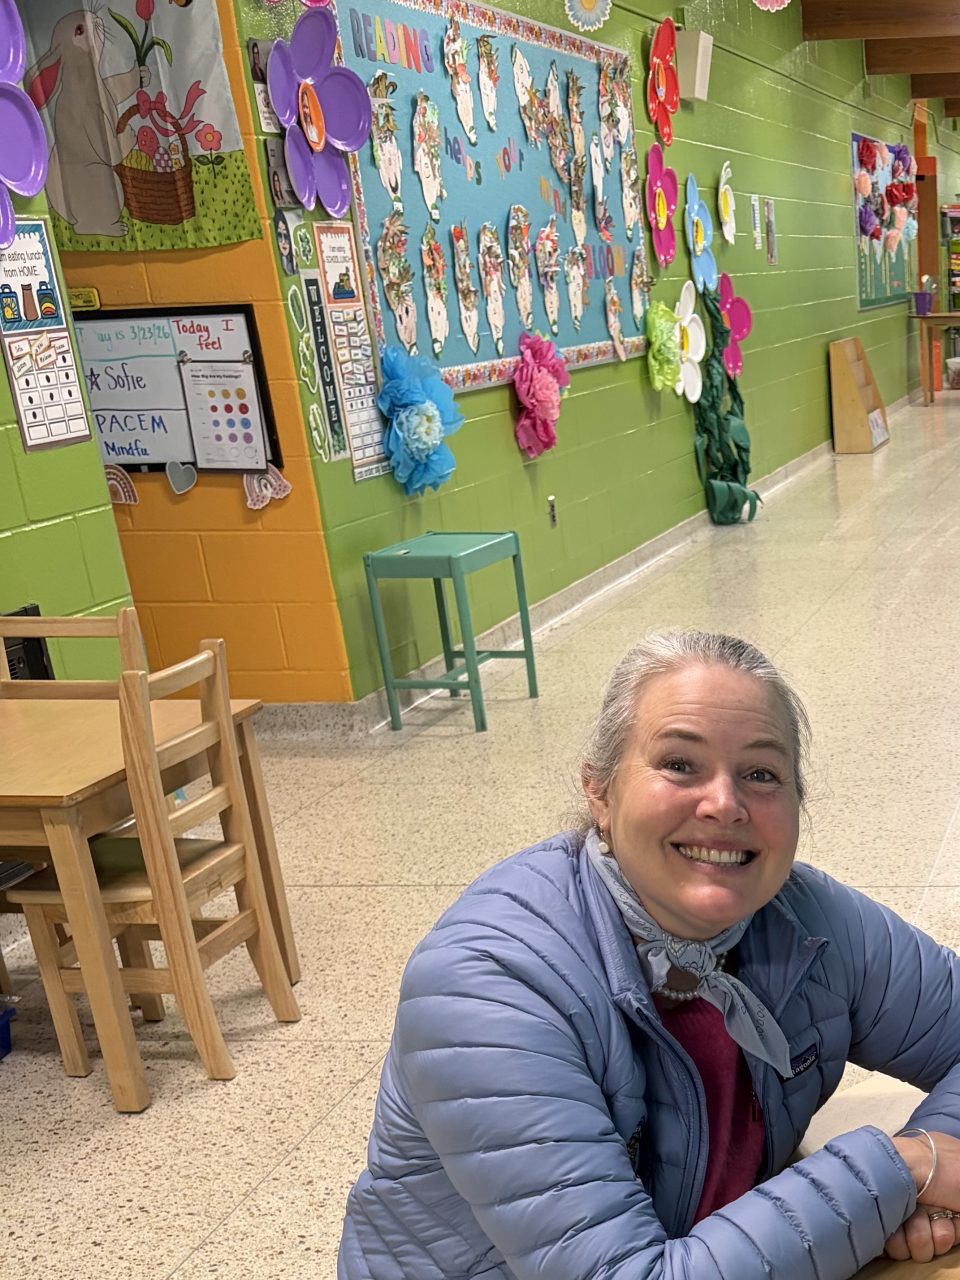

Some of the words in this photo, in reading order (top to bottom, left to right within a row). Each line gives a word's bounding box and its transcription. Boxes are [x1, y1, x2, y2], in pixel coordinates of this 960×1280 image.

[349, 7, 434, 74] READING
[444, 126, 482, 185] helps
[496, 136, 525, 180] your
[7, 251, 27, 263] eating
[26, 250, 43, 260] lunch
[3, 266, 19, 278] from
[172, 319, 210, 341] Today
[222, 319, 235, 332] I
[197, 335, 222, 351] feel
[308, 285, 338, 421] WELCOME
[104, 362, 146, 391] Sofie
[95, 413, 168, 434] PACEM
[792, 1054, 816, 1075] tagonia
